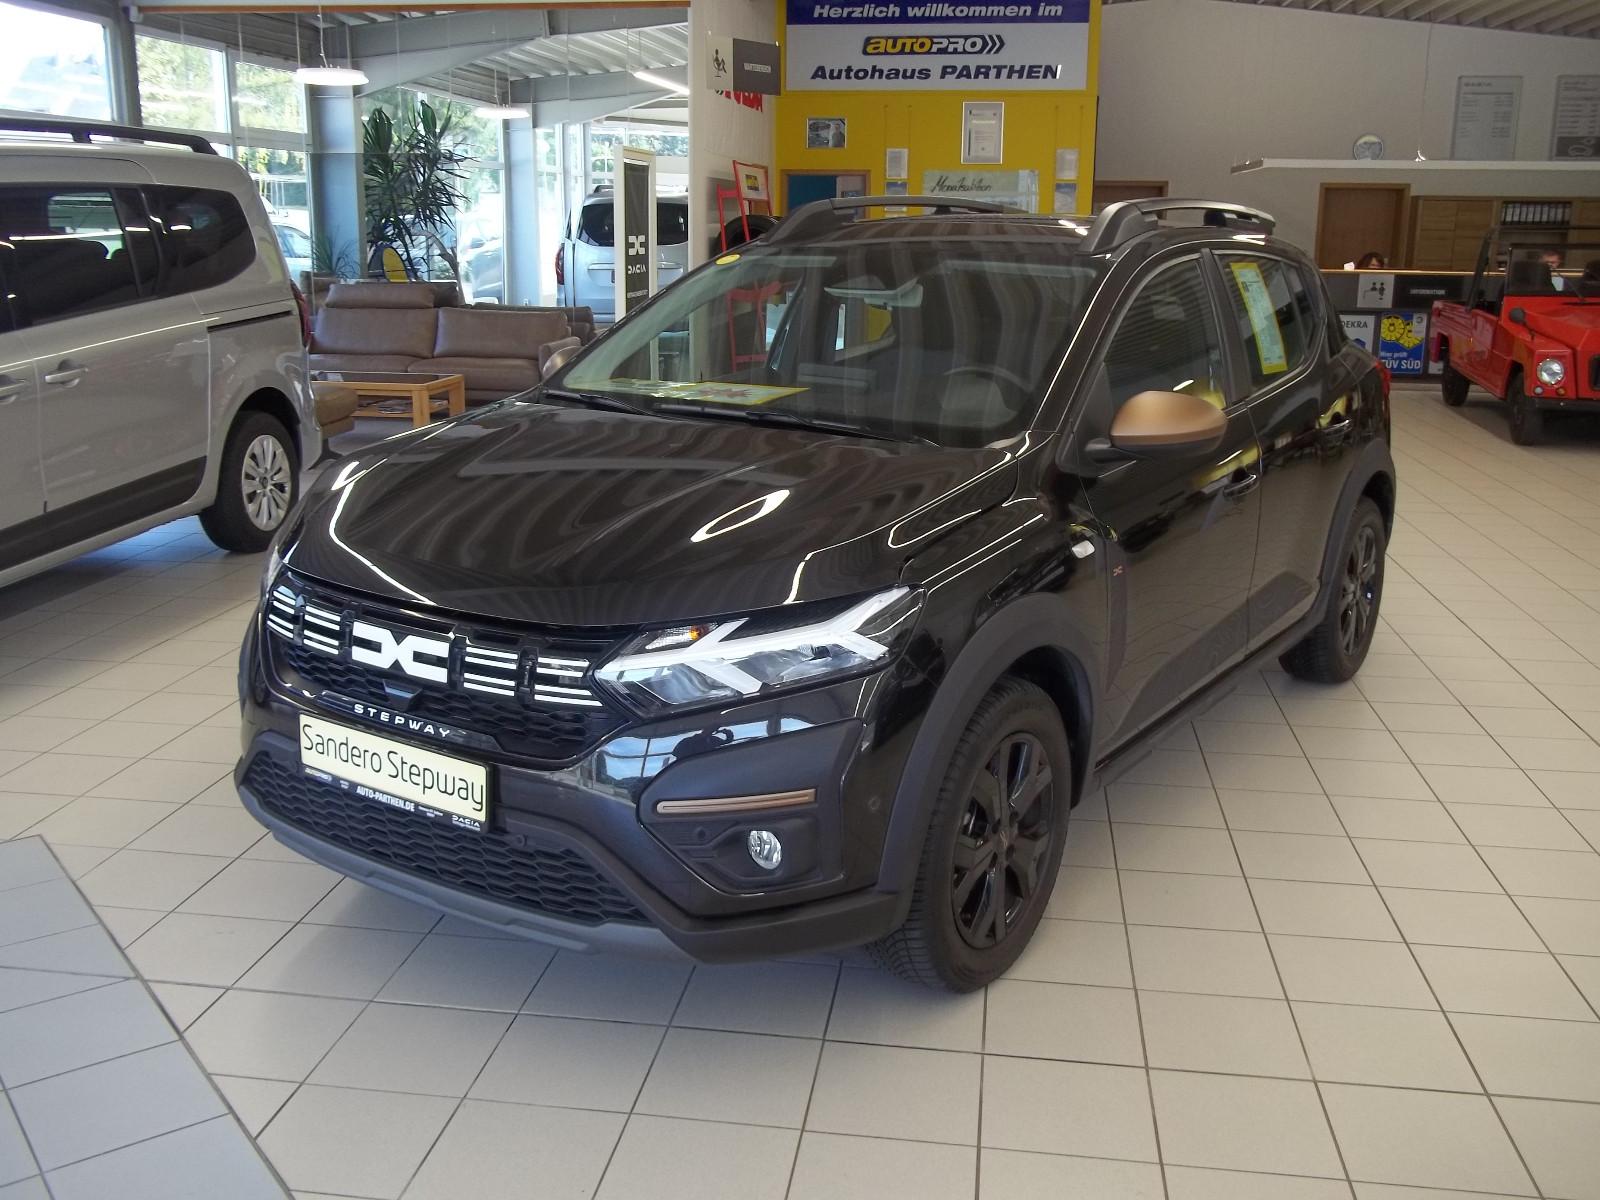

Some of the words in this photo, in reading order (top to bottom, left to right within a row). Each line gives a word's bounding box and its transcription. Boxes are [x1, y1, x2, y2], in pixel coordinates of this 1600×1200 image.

[813, 4, 900, 18] Herzlich
[907, 3, 1032, 18] willkommen
[1038, 2, 1063, 17] im
[810, 65, 932, 81] Autohaus
[940, 64, 1062, 80] PARTHEN
[627, 264, 647, 275] DACIA
[1400, 358, 1421, 369] SÜD
[353, 703, 450, 738] STEPWAY
[302, 723, 382, 773] Sandero
[387, 750, 484, 812] Stepway
